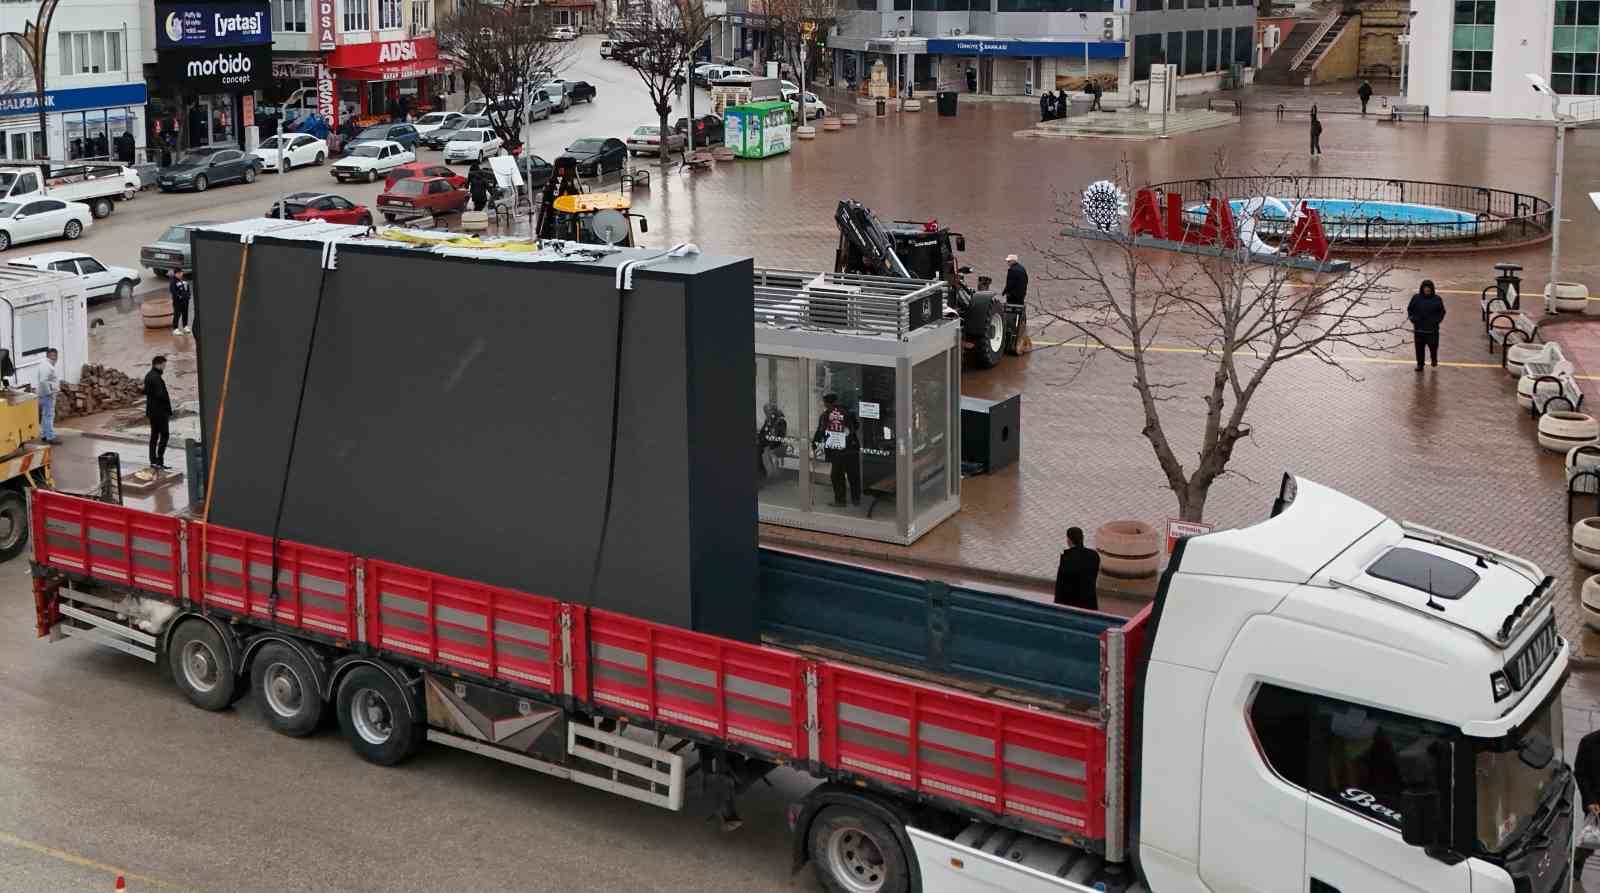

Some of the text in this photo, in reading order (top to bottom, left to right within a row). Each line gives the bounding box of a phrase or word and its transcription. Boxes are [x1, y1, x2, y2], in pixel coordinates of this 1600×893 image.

[321, 0, 334, 41] DSA
[380, 41, 417, 62] ADSA
[187, 52, 251, 77] morbido
[222, 74, 251, 85] concept
[1131, 186, 1330, 263] ALACA
